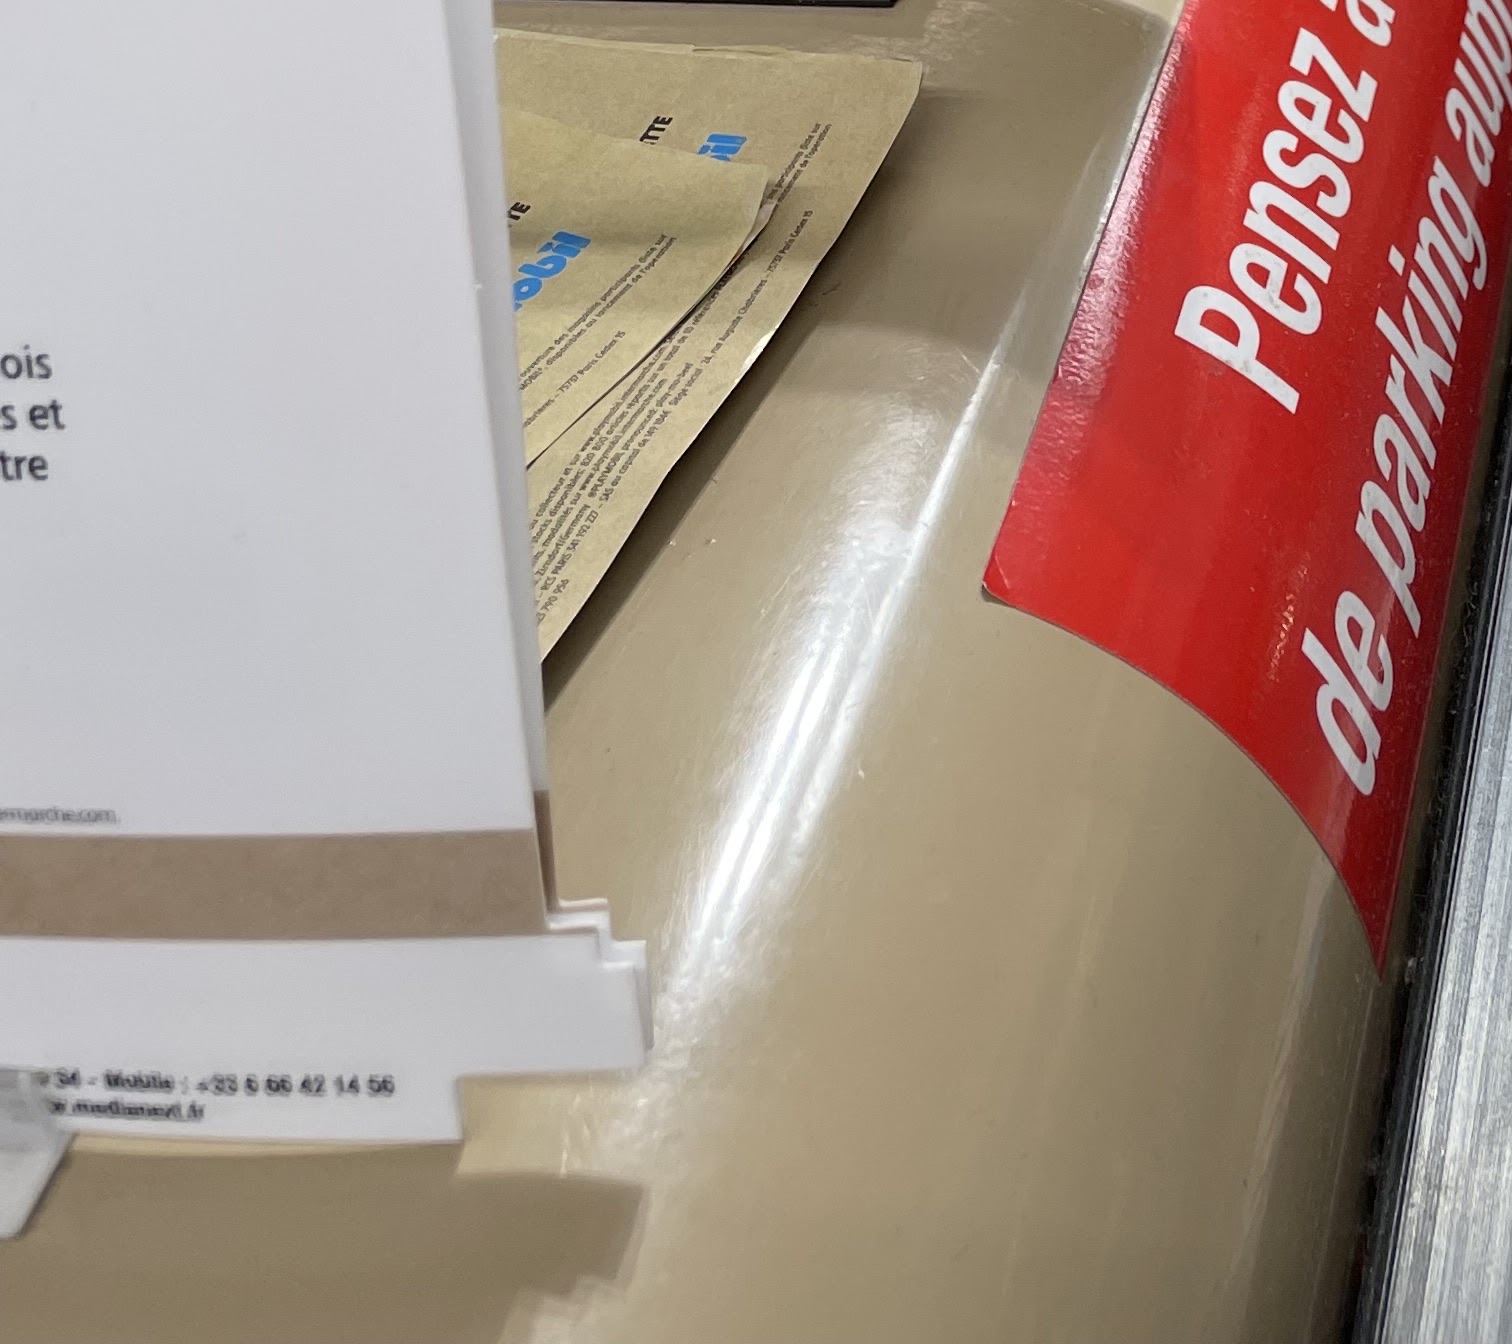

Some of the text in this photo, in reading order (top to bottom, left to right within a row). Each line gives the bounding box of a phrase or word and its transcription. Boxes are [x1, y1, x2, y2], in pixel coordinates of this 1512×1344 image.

[1174, 26, 1378, 413] Pensez
[0, 344, 52, 380] ois
[29, 399, 66, 430] et
[0, 451, 48, 481] tre
[1301, 589, 1394, 796] de
[1356, 156, 1490, 637] parking
[103, 1070, 174, 1092] Mobile
